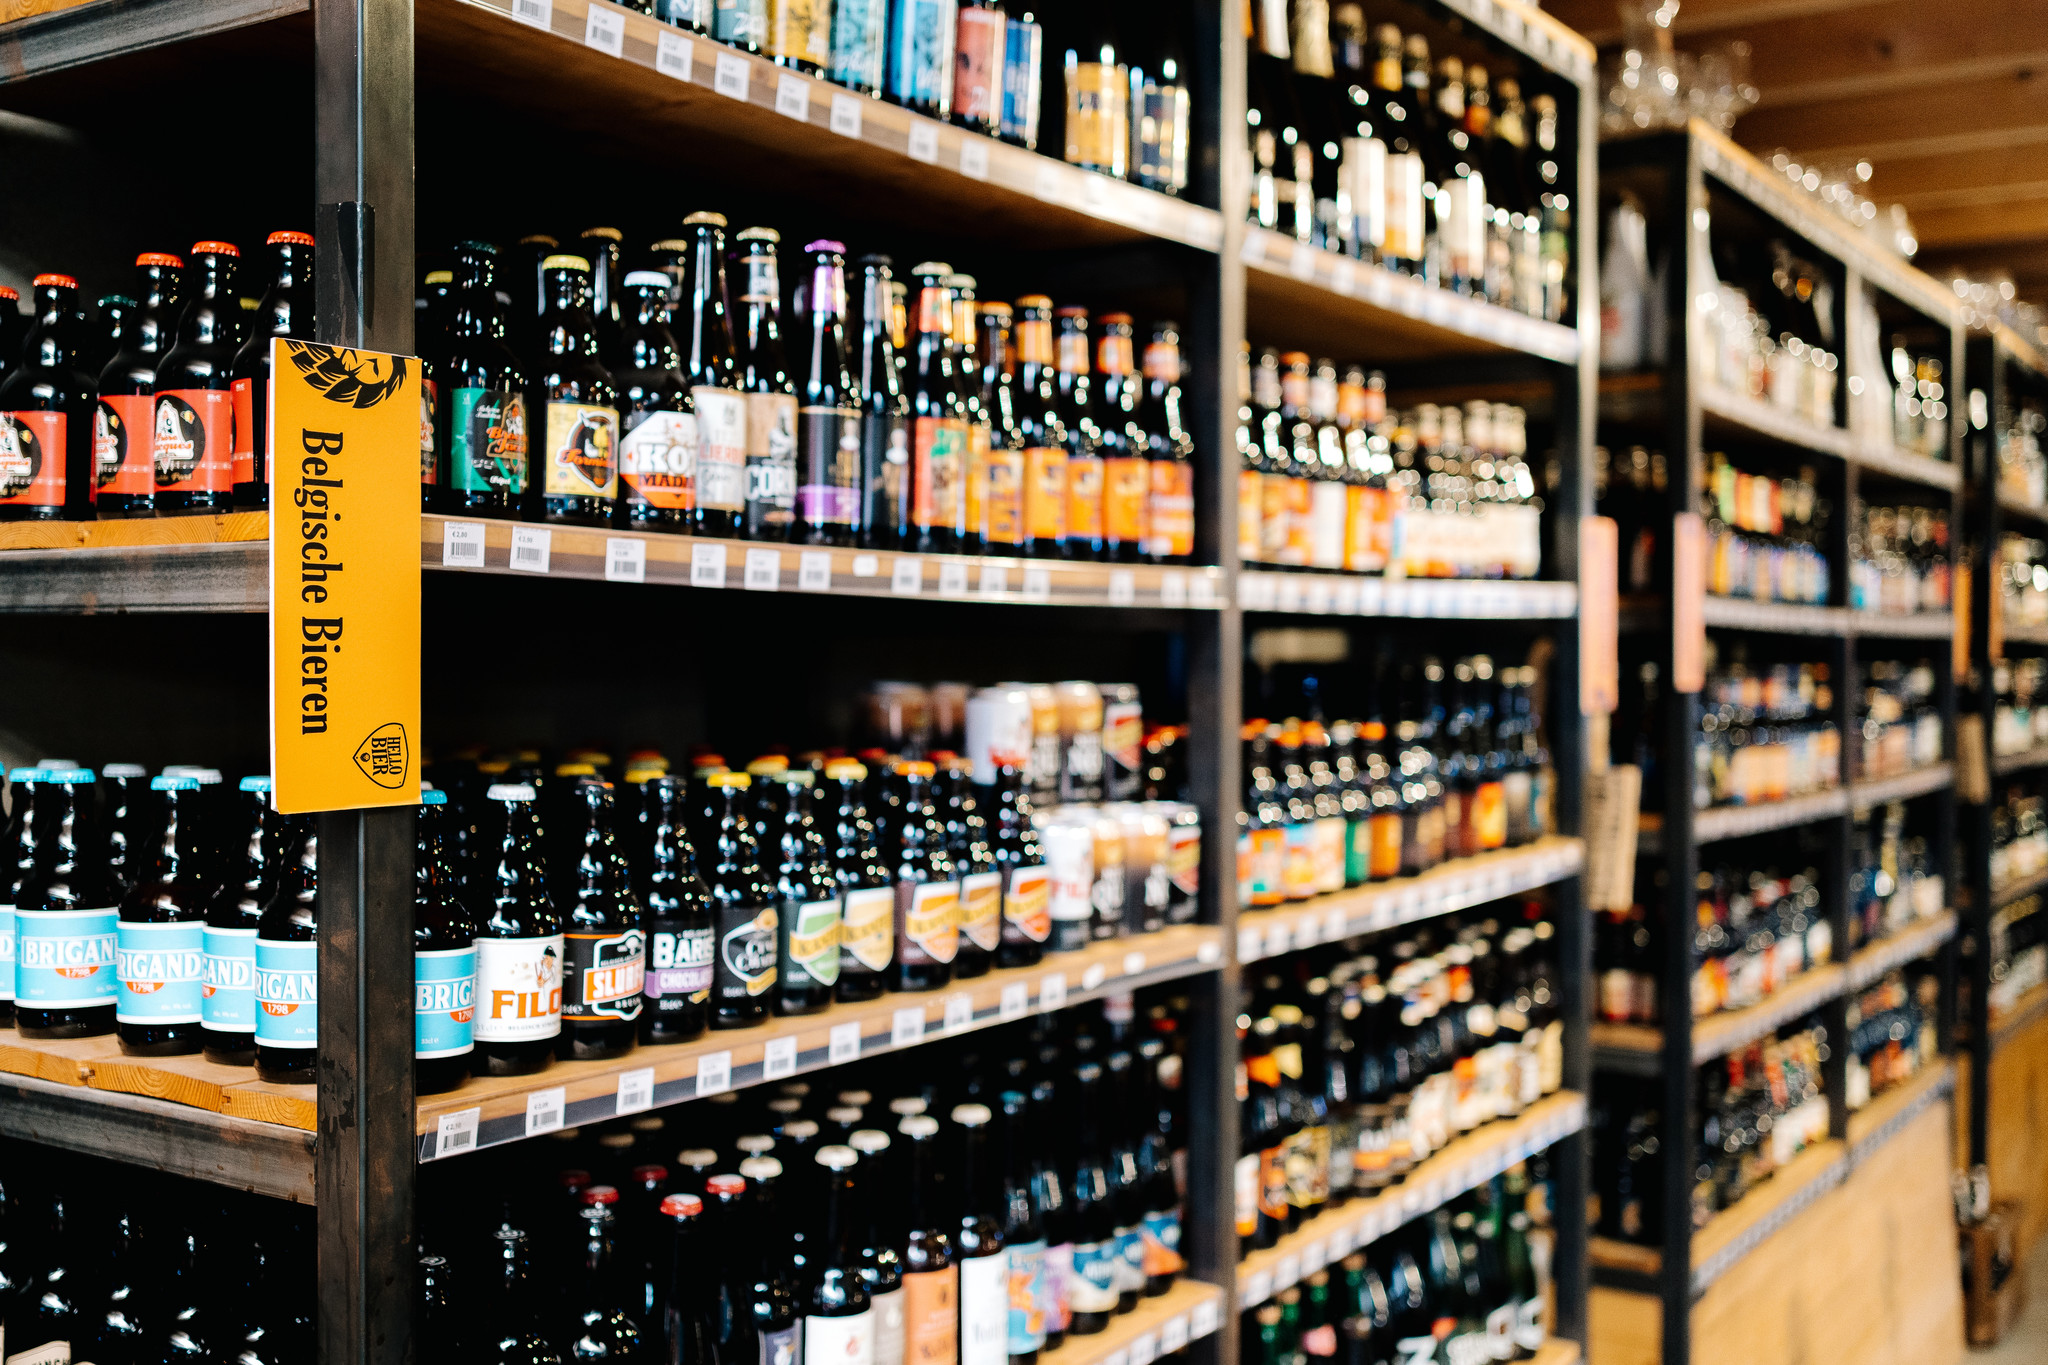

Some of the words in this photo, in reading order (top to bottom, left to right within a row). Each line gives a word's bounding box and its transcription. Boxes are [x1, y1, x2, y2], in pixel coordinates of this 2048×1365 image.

[294, 428, 343, 603] Belgische
[302, 616, 343, 735] Bieren
[371, 737, 389, 776] BIER
[387, 736, 402, 775] HELLO
[25, 937, 118, 964] BRIGAN
[117, 953, 201, 979] RIGAND
[653, 932, 715, 968] BARIS
[202, 960, 249, 986] GAND
[256, 972, 316, 1000] RIGAN
[267, 1003, 289, 1015] 1798
[490, 986, 562, 1019] FILO
